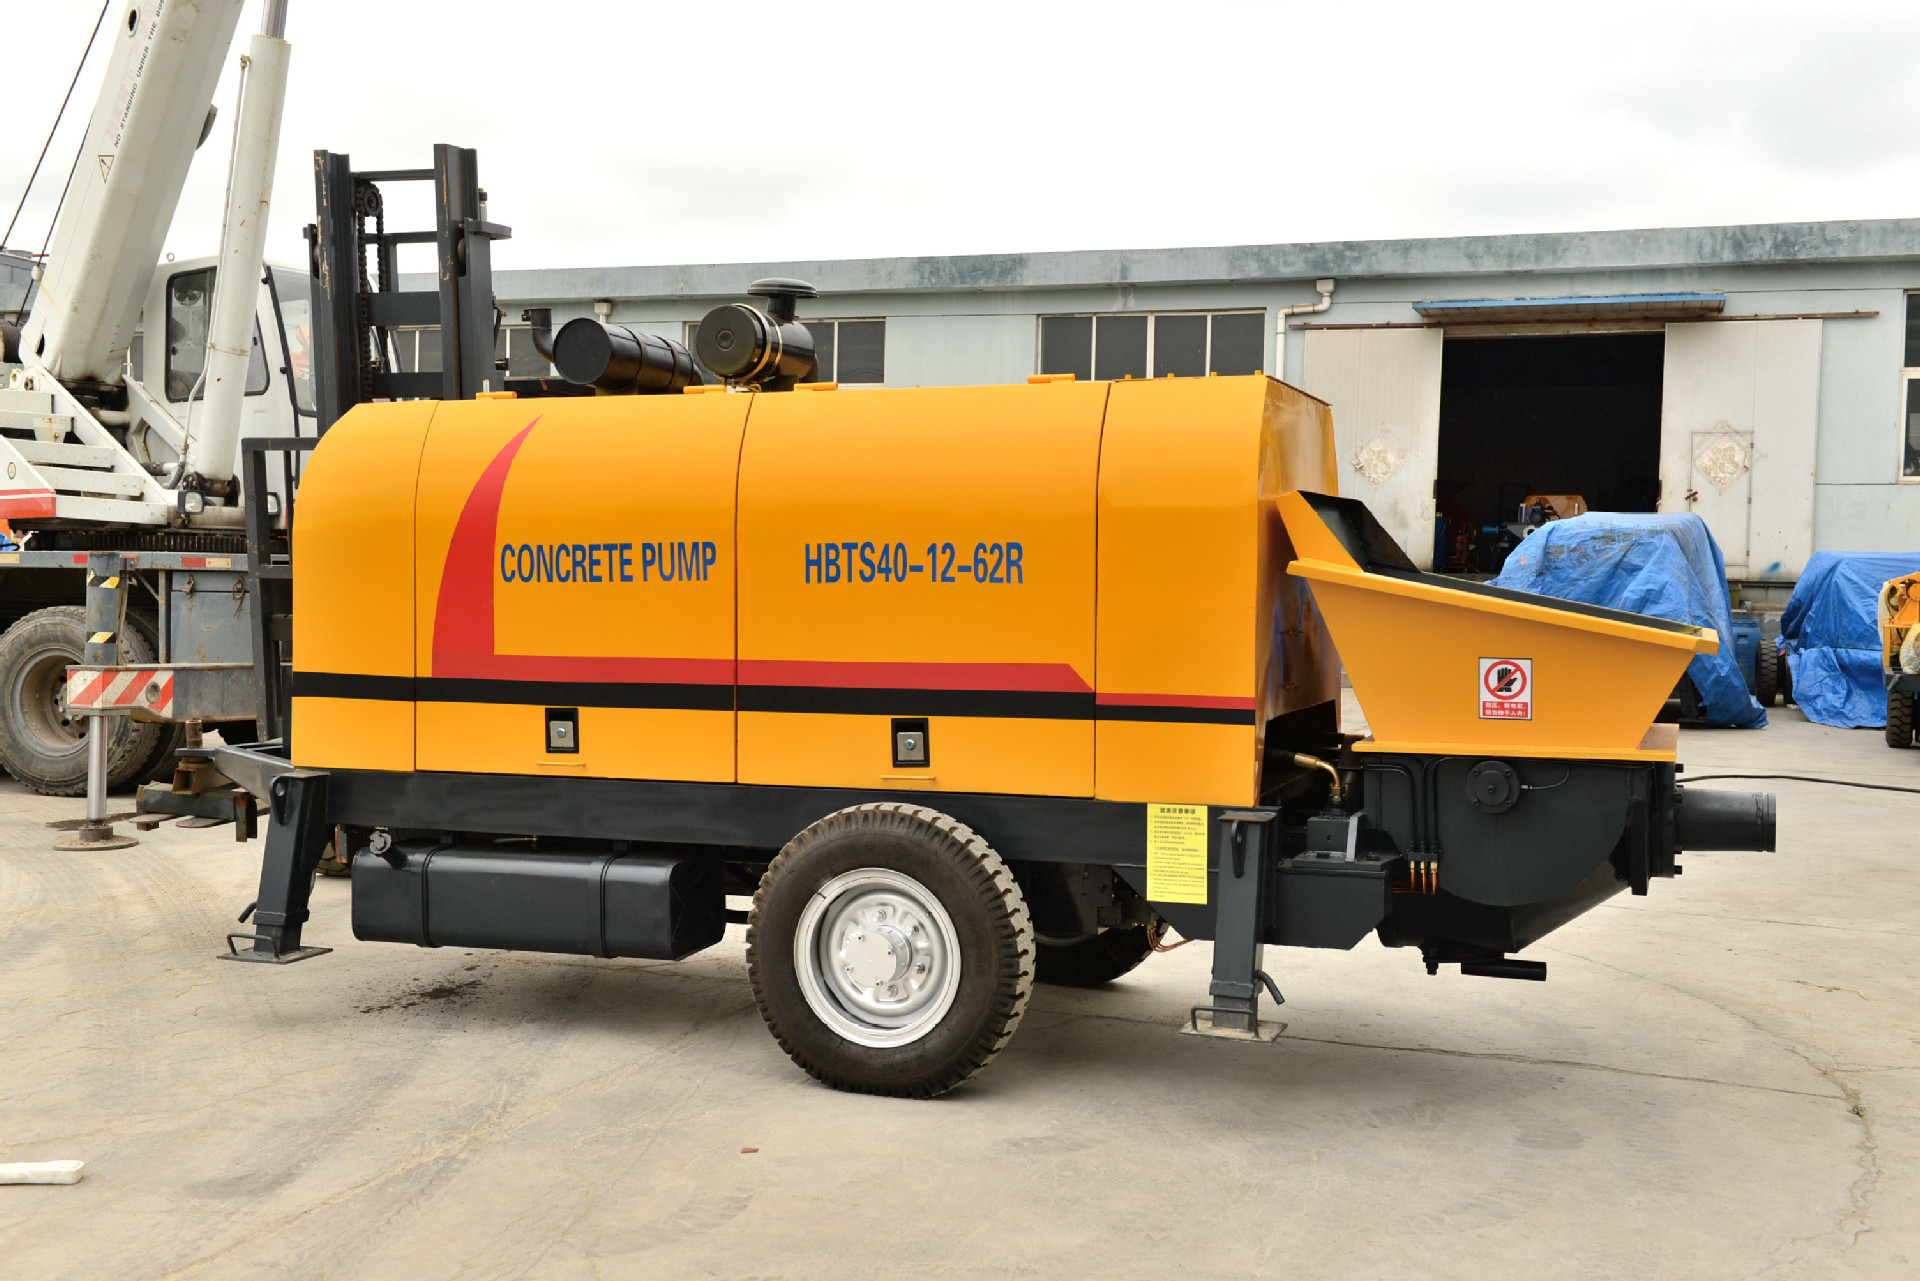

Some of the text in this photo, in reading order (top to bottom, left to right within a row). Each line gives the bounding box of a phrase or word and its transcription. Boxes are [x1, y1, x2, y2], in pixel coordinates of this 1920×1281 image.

[113, 133, 121, 148] NO
[119, 82, 138, 130] STANDING
[136, 45, 149, 78] UNDER
[147, 21, 158, 40] THE
[500, 541, 717, 583] CONCRETE PUMP
[804, 541, 1024, 584] HBTS40-12-62R
